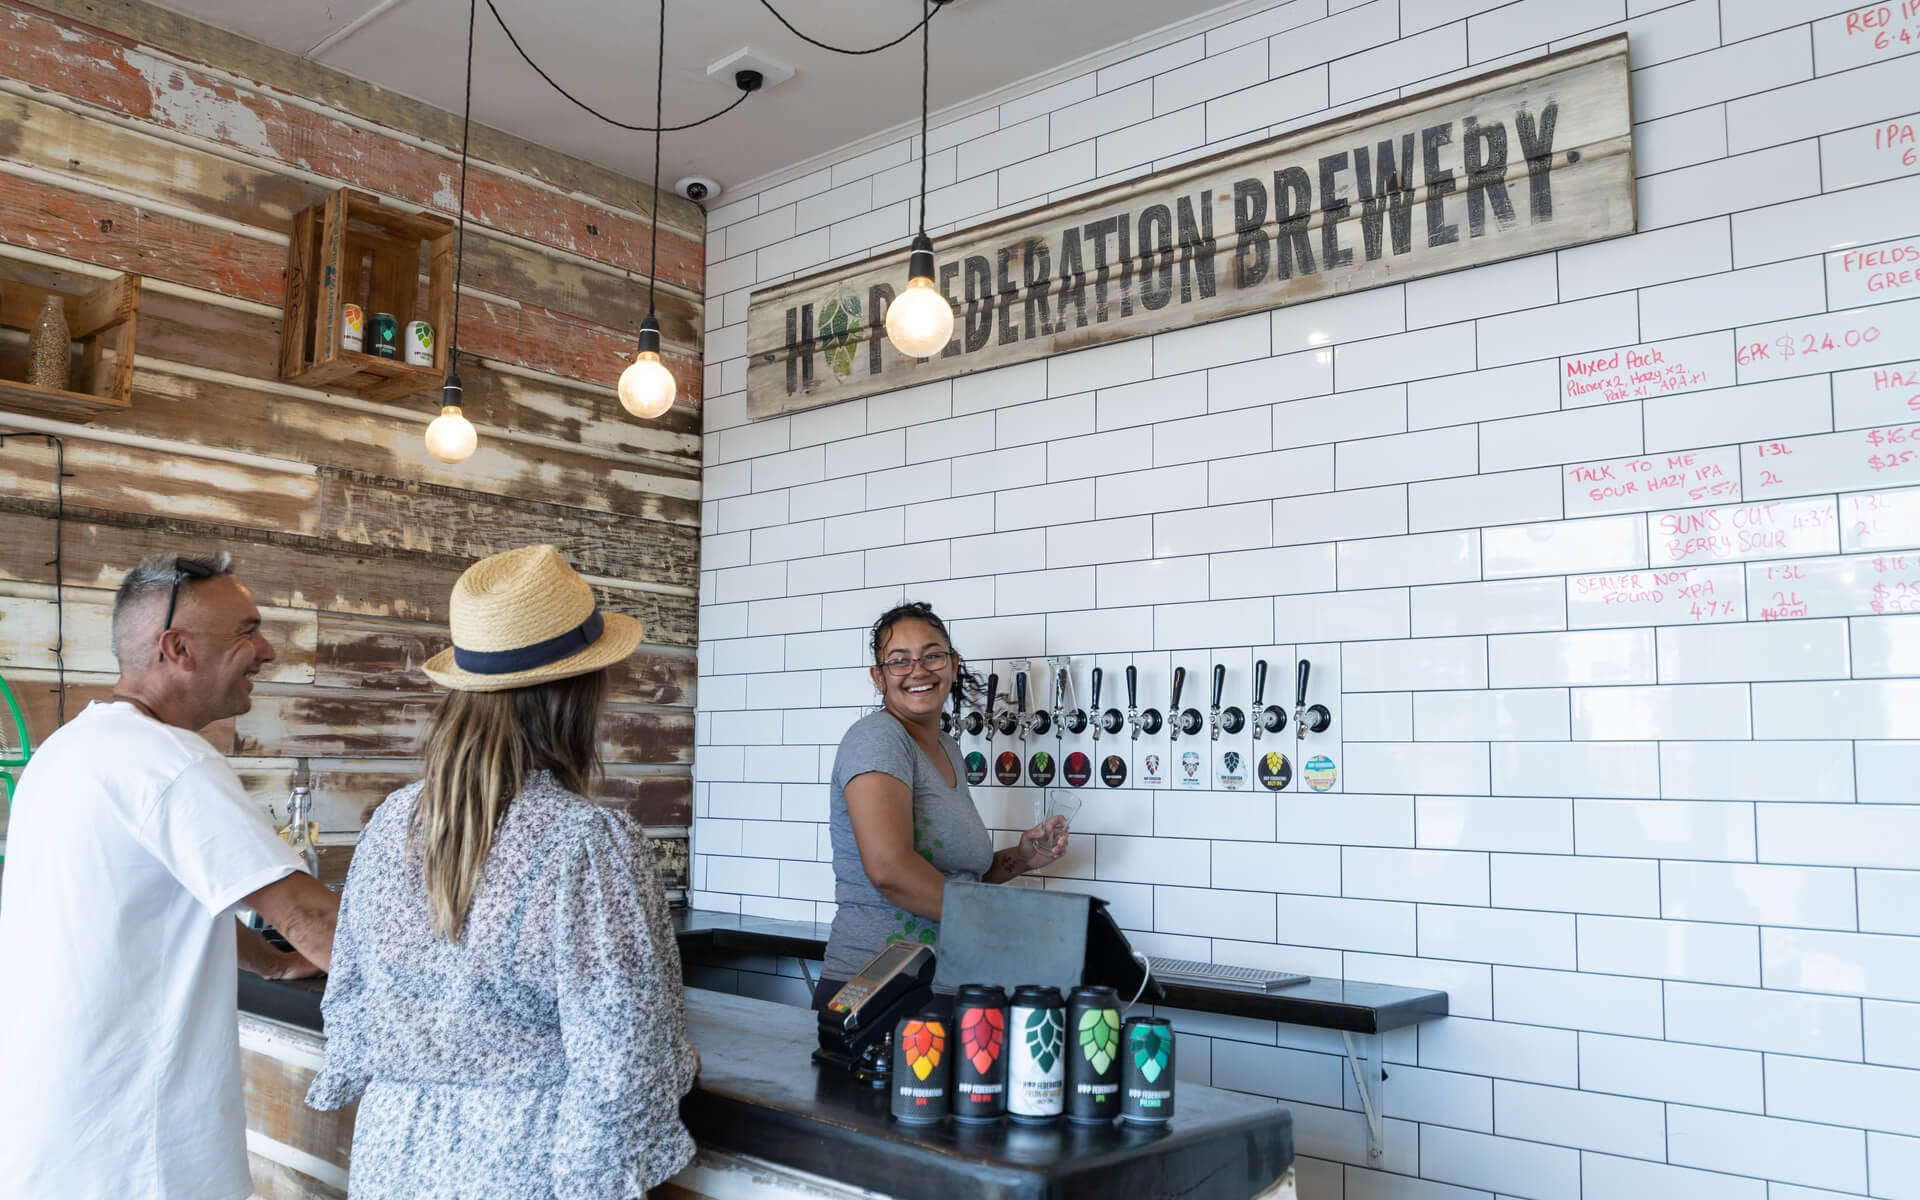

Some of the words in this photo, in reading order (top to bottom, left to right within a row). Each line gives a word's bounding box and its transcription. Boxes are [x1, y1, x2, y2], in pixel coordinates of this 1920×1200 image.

[1846, 7, 1891, 35] RED
[1876, 124, 1916, 149] IPA
[785, 281, 894, 396] HP
[915, 187, 1216, 364] EDERATION
[1233, 99, 1559, 290] BREWERY
[1844, 244, 1920, 273] FIELDS
[1567, 352, 1619, 378] Mixed
[1626, 347, 1665, 370] Pack
[1736, 342, 1771, 366] 6PK
[1604, 387, 1629, 402] Pale
[1660, 374, 1688, 392] APA
[1630, 370, 1663, 385] Hazy
[1570, 465, 1616, 483] TALK
[1625, 459, 1653, 473] TO
[1667, 453, 1697, 470] ME
[1760, 470, 1783, 488] 2L
[1589, 481, 1639, 502] SOUR
[1647, 473, 1686, 493] HAZY
[1696, 463, 1724, 481] IPA
[1659, 507, 1721, 536] SUN'S
[1731, 502, 1782, 530] OUT
[1738, 529, 1787, 553] SOUR
[1576, 573, 1643, 595] SERVER
[1652, 567, 1698, 586] NOT
[1603, 589, 1665, 605] FOUND
[1678, 579, 1716, 600] XPA
[1772, 590, 1804, 607] 2L
